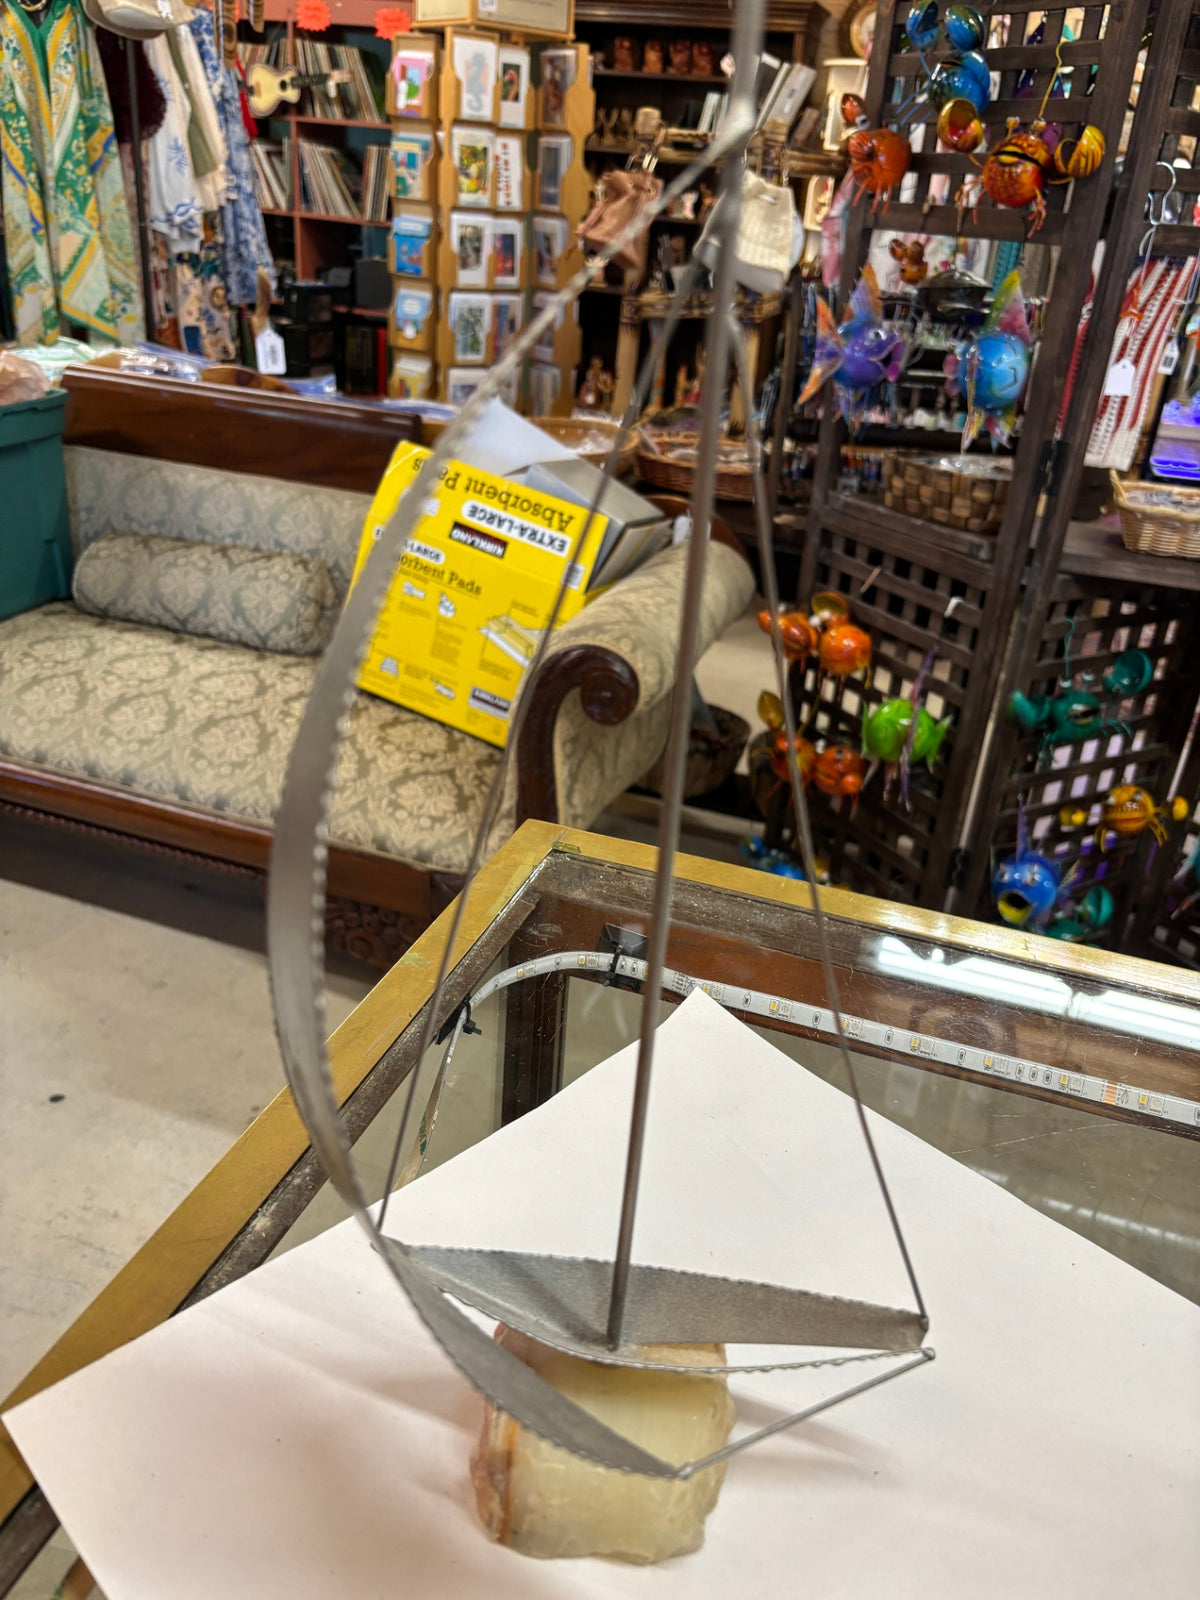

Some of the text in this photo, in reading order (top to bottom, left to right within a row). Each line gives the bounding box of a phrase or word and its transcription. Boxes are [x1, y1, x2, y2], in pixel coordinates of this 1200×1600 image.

[412, 457, 574, 531] Absorbent Pas
[451, 528, 505, 558] KIRKLAND
[468, 504, 567, 552] EXTRA-LARGE
[400, 554, 444, 580] orbent
[448, 571, 482, 596] Pads
